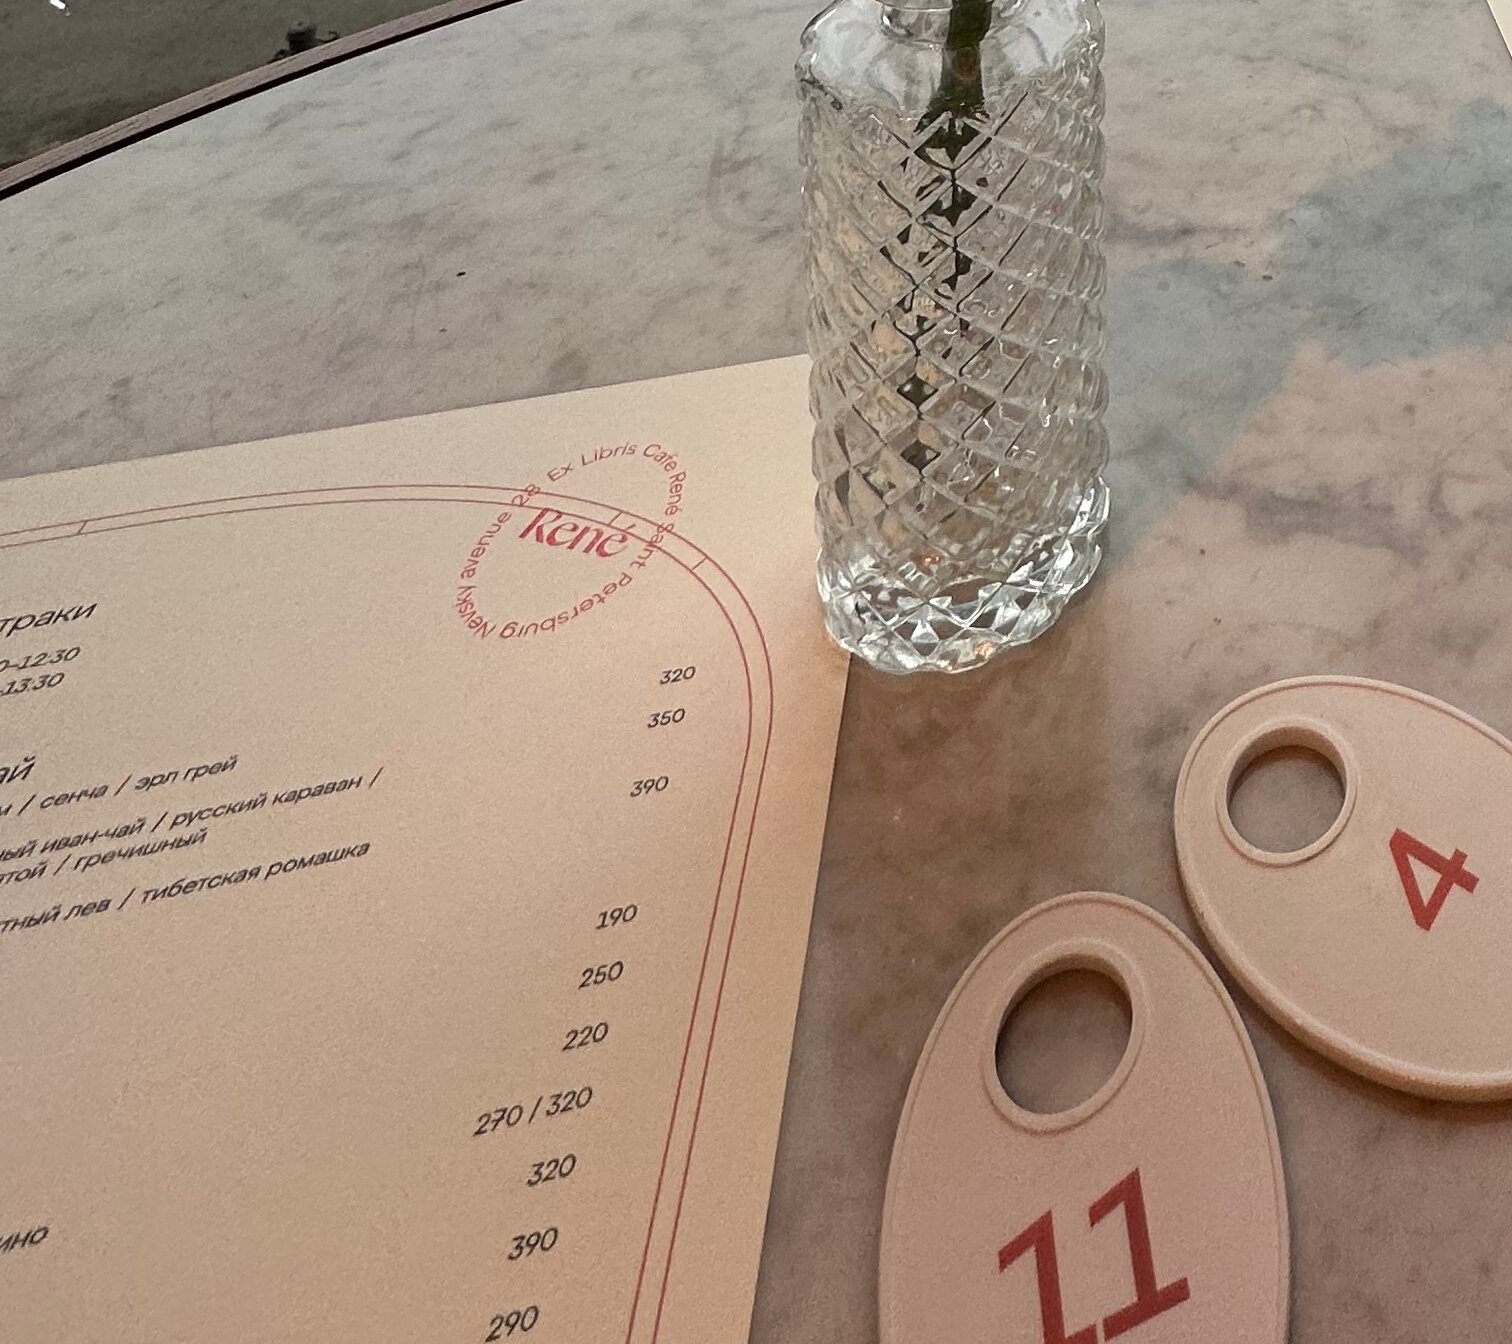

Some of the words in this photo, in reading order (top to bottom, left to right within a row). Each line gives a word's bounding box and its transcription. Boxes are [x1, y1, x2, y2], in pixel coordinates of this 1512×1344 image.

[546, 463, 574, 482] Ex
[581, 442, 638, 466] Libris
[511, 484, 541, 507] 28
[460, 512, 512, 579] avenue
[519, 507, 637, 558] René
[630, 521, 675, 569] Saint
[455, 584, 497, 640] Nevsky
[499, 572, 633, 639] Petersburg
[659, 666, 696, 686] 320
[647, 708, 686, 729] 350
[40, 785, 109, 811] сенча
[133, 770, 180, 792] эрл
[183, 755, 239, 783] грей
[630, 776, 669, 798] 390
[40, 817, 147, 855] иван-чай
[168, 792, 268, 831] русский
[272, 776, 363, 806] караван
[62, 899, 112, 922] лев
[141, 865, 262, 904] тибетская
[263, 843, 370, 882] ромашка
[1389, 828, 1480, 932] 4
[595, 904, 638, 930] 190
[578, 961, 624, 990] 250
[561, 1021, 609, 1052] 220
[472, 1104, 524, 1138] 270
[545, 1086, 593, 1119] 320
[525, 1154, 577, 1187] 320
[507, 1226, 559, 1262] 390
[998, 1168, 1190, 1344] 11
[484, 1305, 540, 1344] 290
